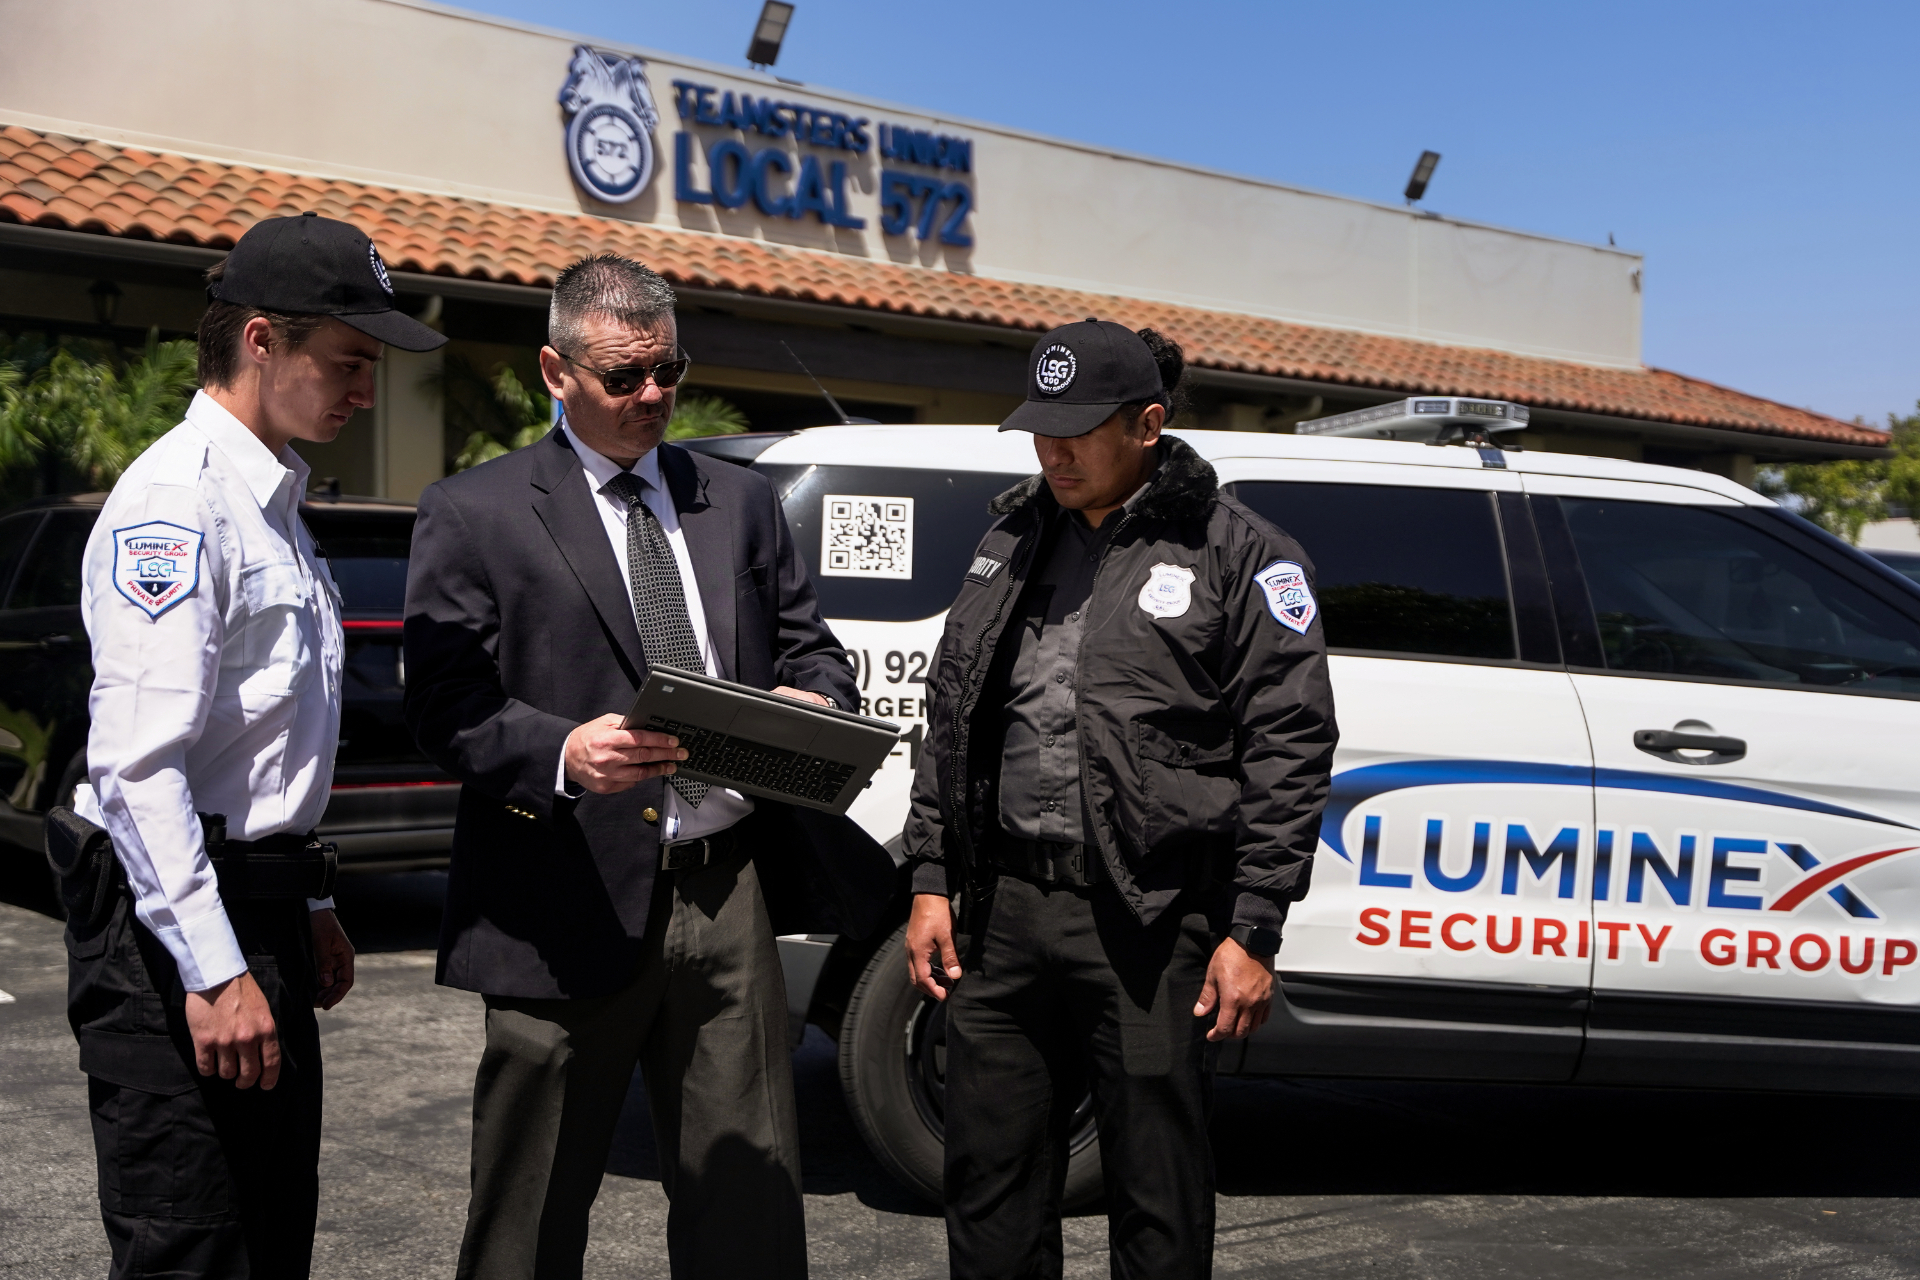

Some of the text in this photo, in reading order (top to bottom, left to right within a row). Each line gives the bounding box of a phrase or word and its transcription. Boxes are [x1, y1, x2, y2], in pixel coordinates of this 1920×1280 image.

[672, 80, 871, 152] TEAMSTERS
[877, 121, 974, 172] UNION
[674, 131, 867, 230] LOCAL
[880, 168, 975, 247] 572
[1041, 359, 1069, 379] LSG
[129, 541, 188, 552] LUMINEX
[140, 561, 172, 578] LSG
[1269, 574, 1301, 587] LUMINEX
[127, 580, 183, 606] PRIVATE SECURITY
[1281, 591, 1303, 607] LSG
[1358, 815, 1919, 920] LUMINEX
[1355, 906, 1919, 976] SECURITY GROUP
